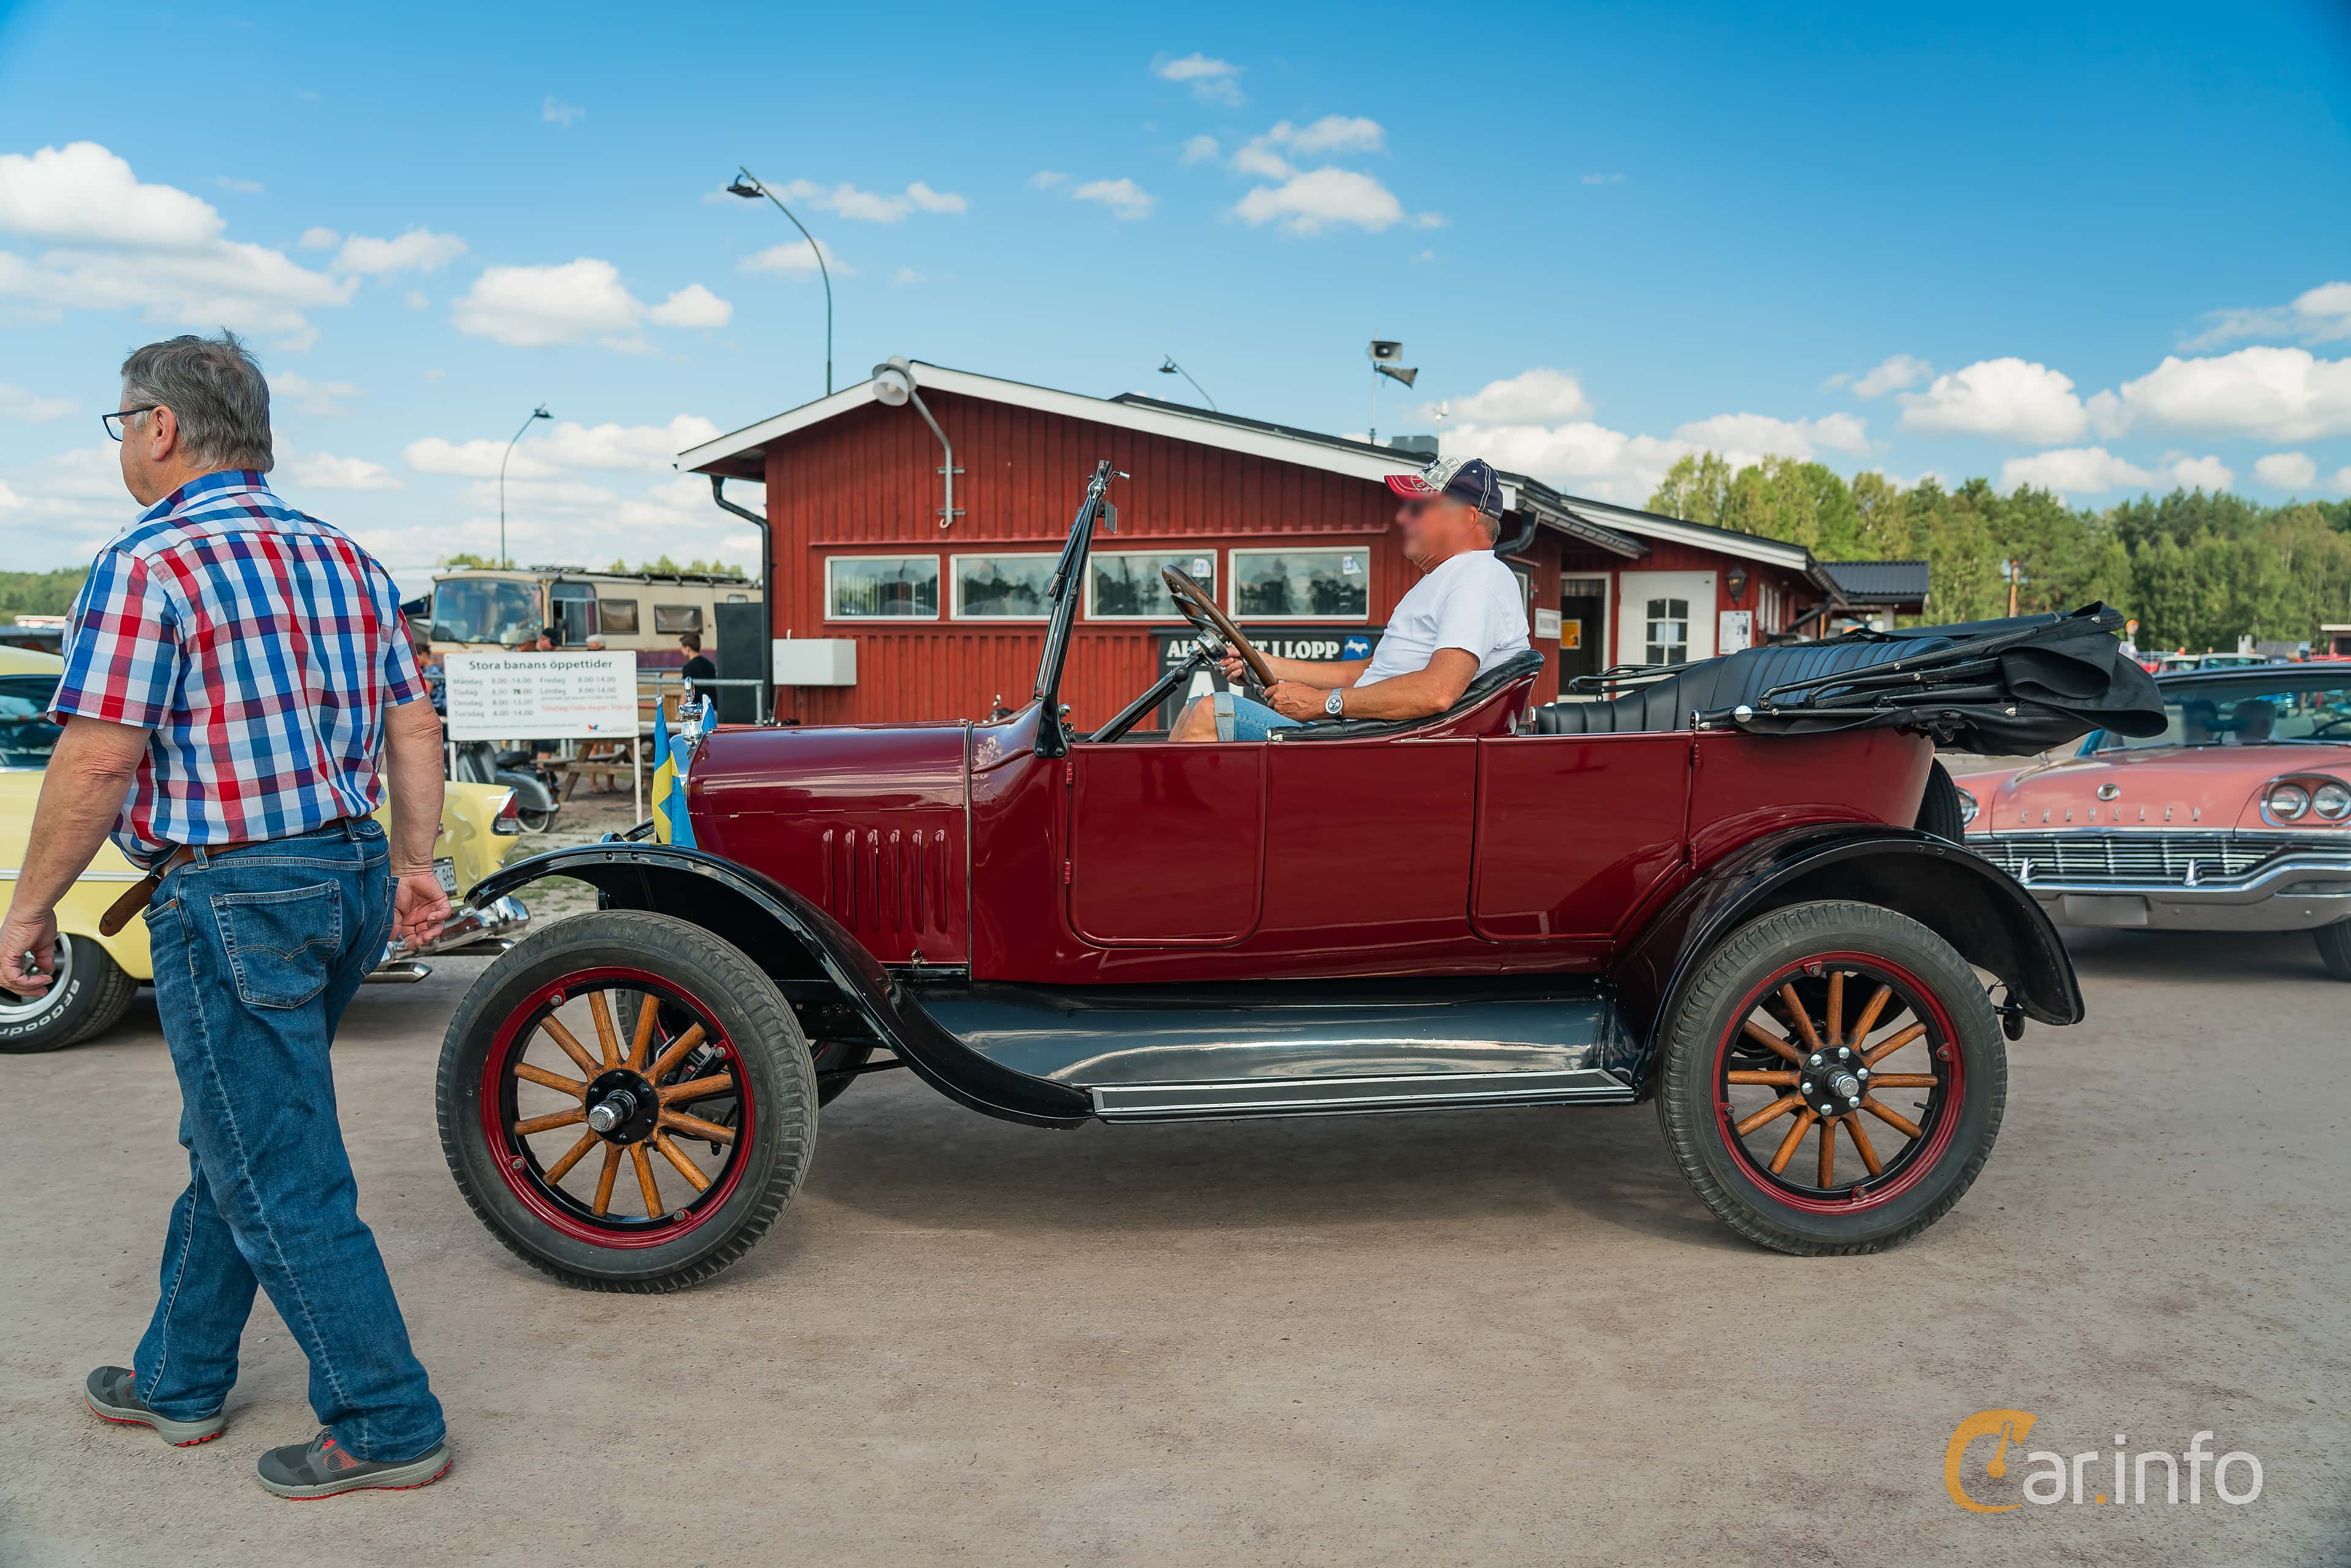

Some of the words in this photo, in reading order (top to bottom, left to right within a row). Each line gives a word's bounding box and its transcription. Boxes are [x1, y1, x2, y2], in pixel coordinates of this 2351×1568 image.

[1286, 640, 1340, 659] LOPP
[470, 661, 500, 670] Stora
[504, 660, 547, 669] banans
[550, 659, 613, 670] öppettider
[2021, 806, 2201, 823] CHRYSLER
